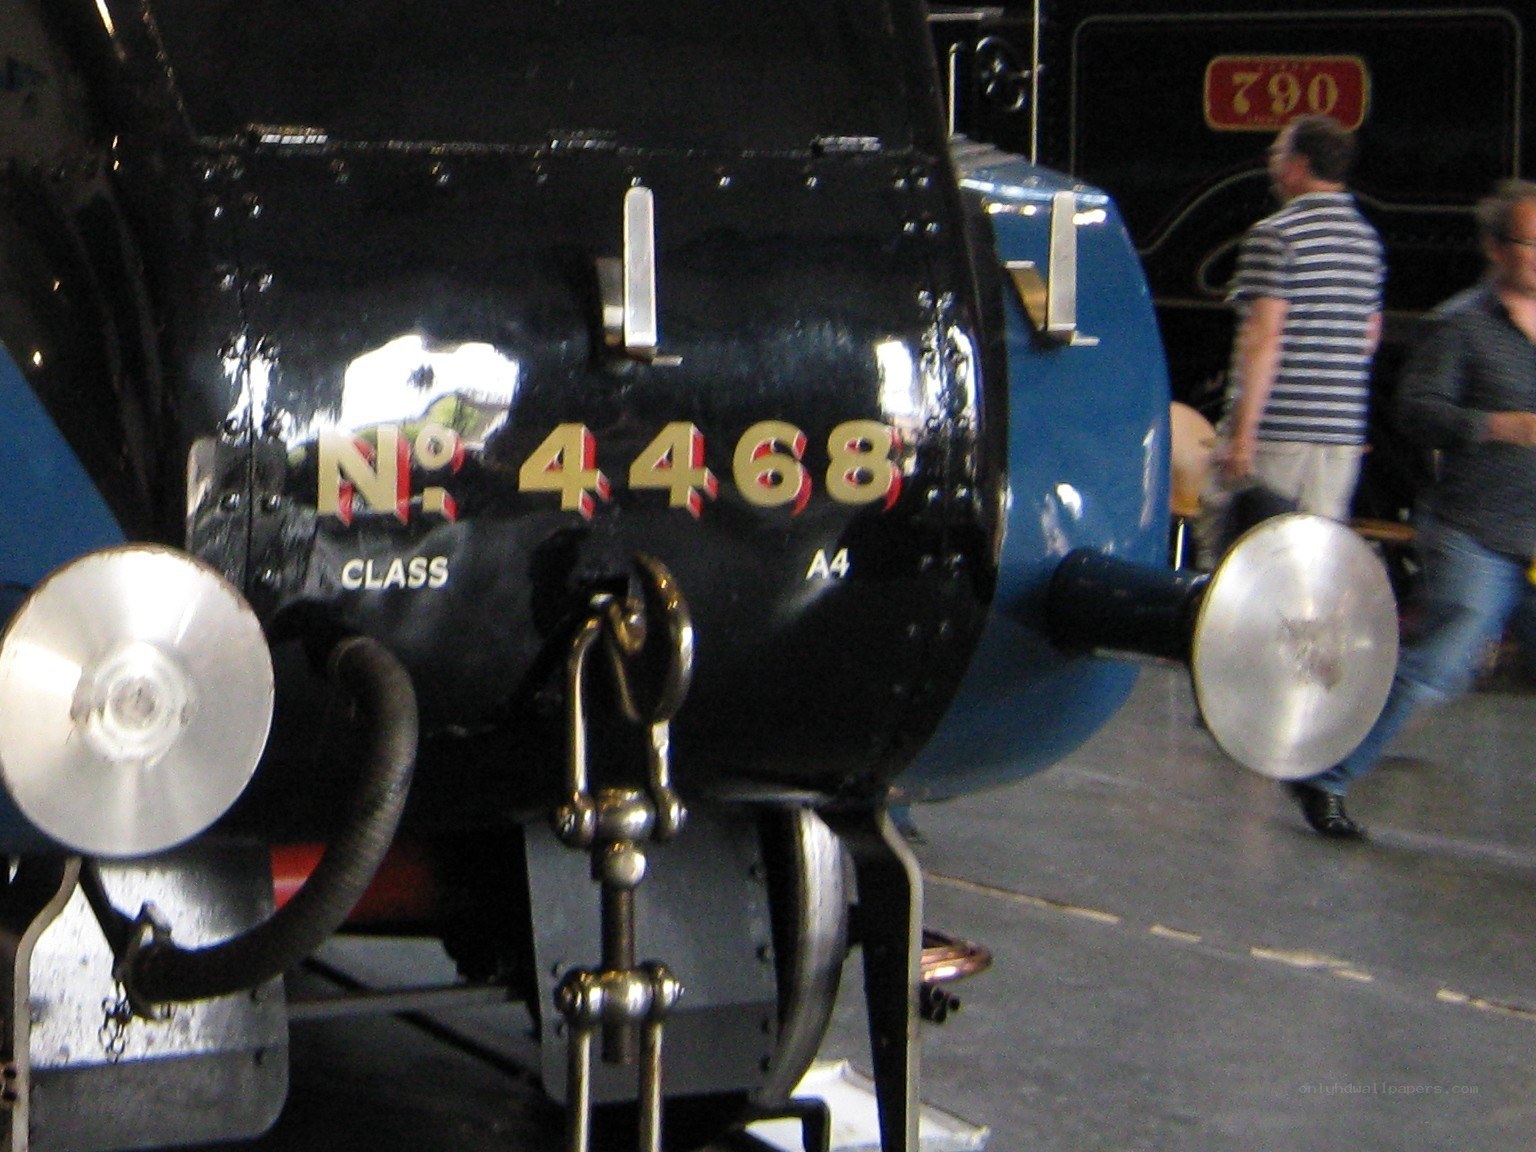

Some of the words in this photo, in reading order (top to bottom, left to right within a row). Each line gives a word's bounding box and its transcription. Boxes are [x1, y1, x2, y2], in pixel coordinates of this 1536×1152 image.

[1232, 67, 1338, 115] 790
[519, 420, 903, 519] 4468
[340, 558, 450, 590] CLASS
[805, 547, 851, 580] A4
